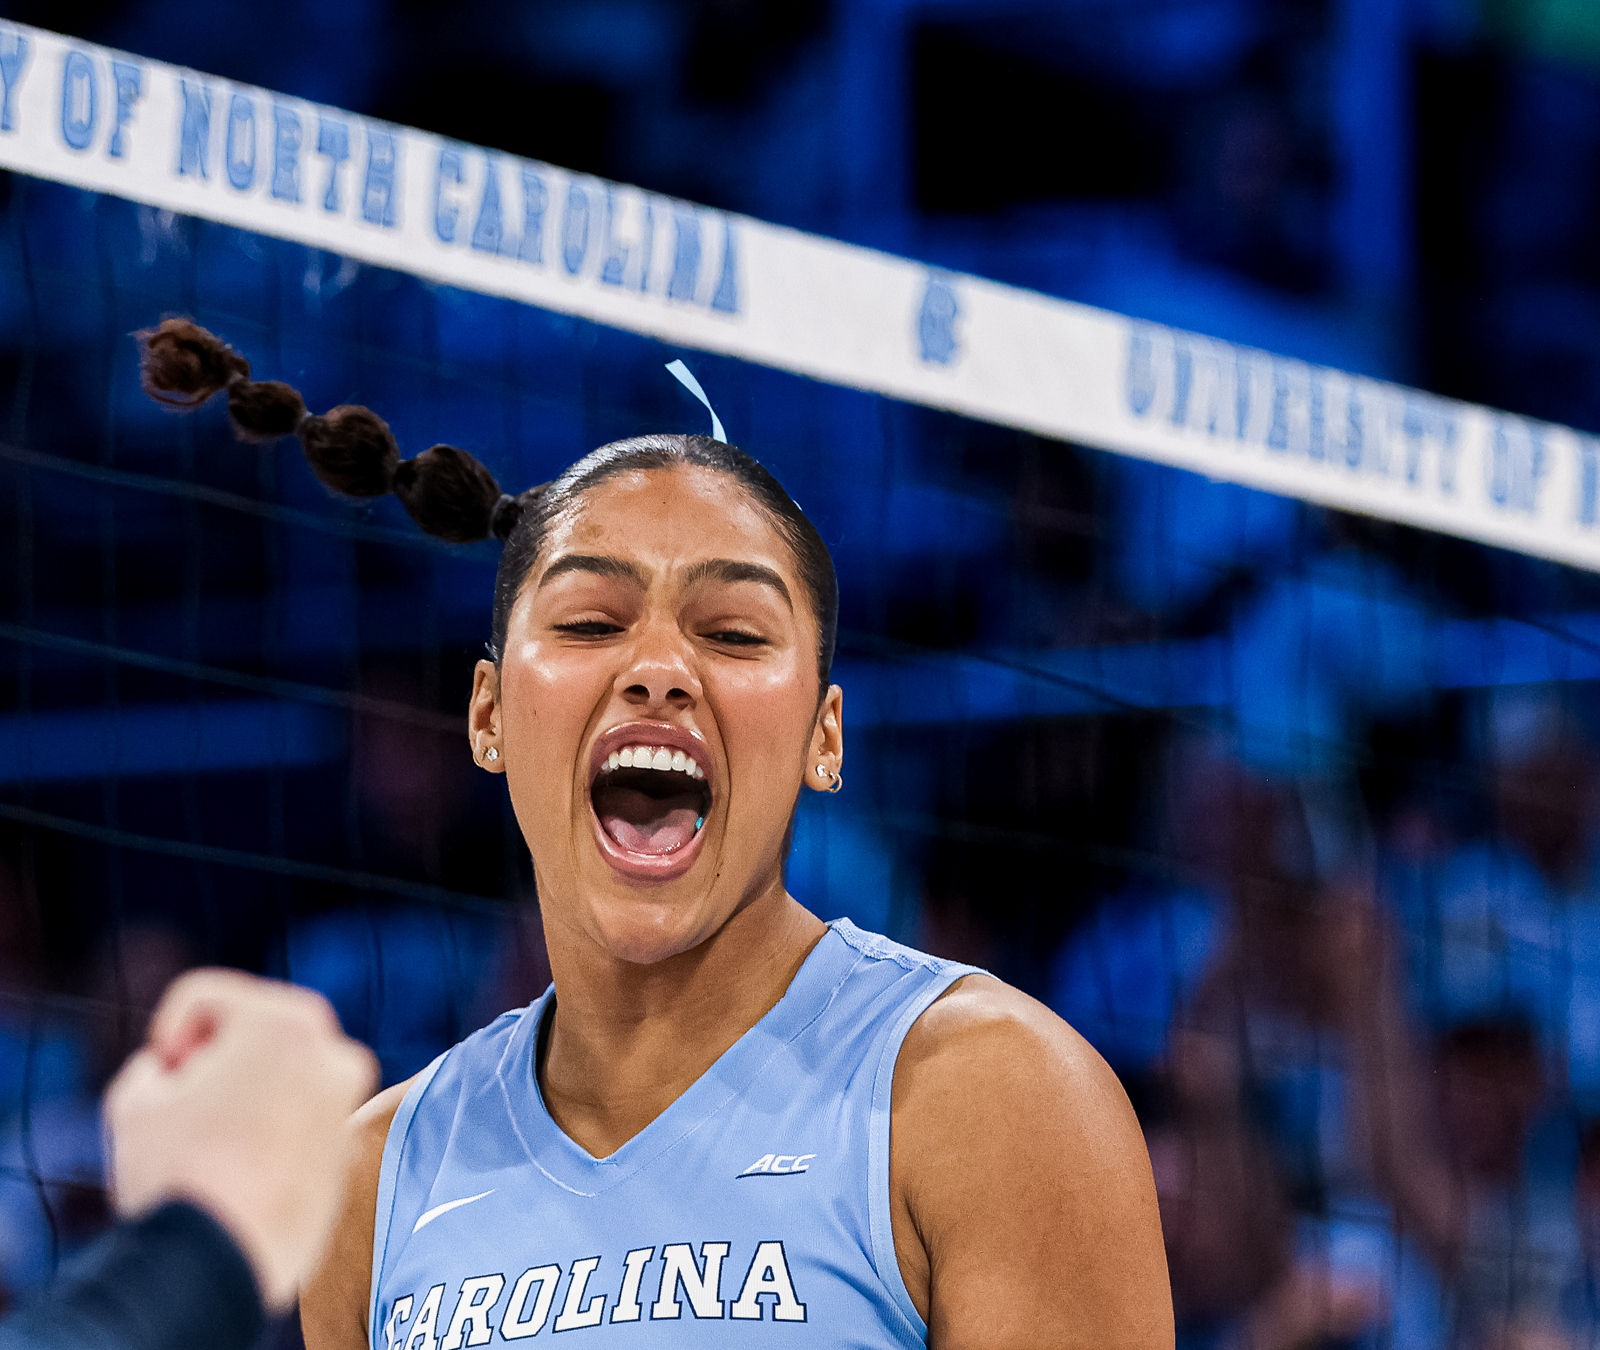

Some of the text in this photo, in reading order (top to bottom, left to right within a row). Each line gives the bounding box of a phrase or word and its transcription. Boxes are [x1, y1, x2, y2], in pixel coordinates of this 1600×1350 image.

[60, 50, 145, 158] OF
[177, 76, 398, 229] NORTH
[433, 146, 741, 315] CAROLINA
[741, 1153, 818, 1174] ACC
